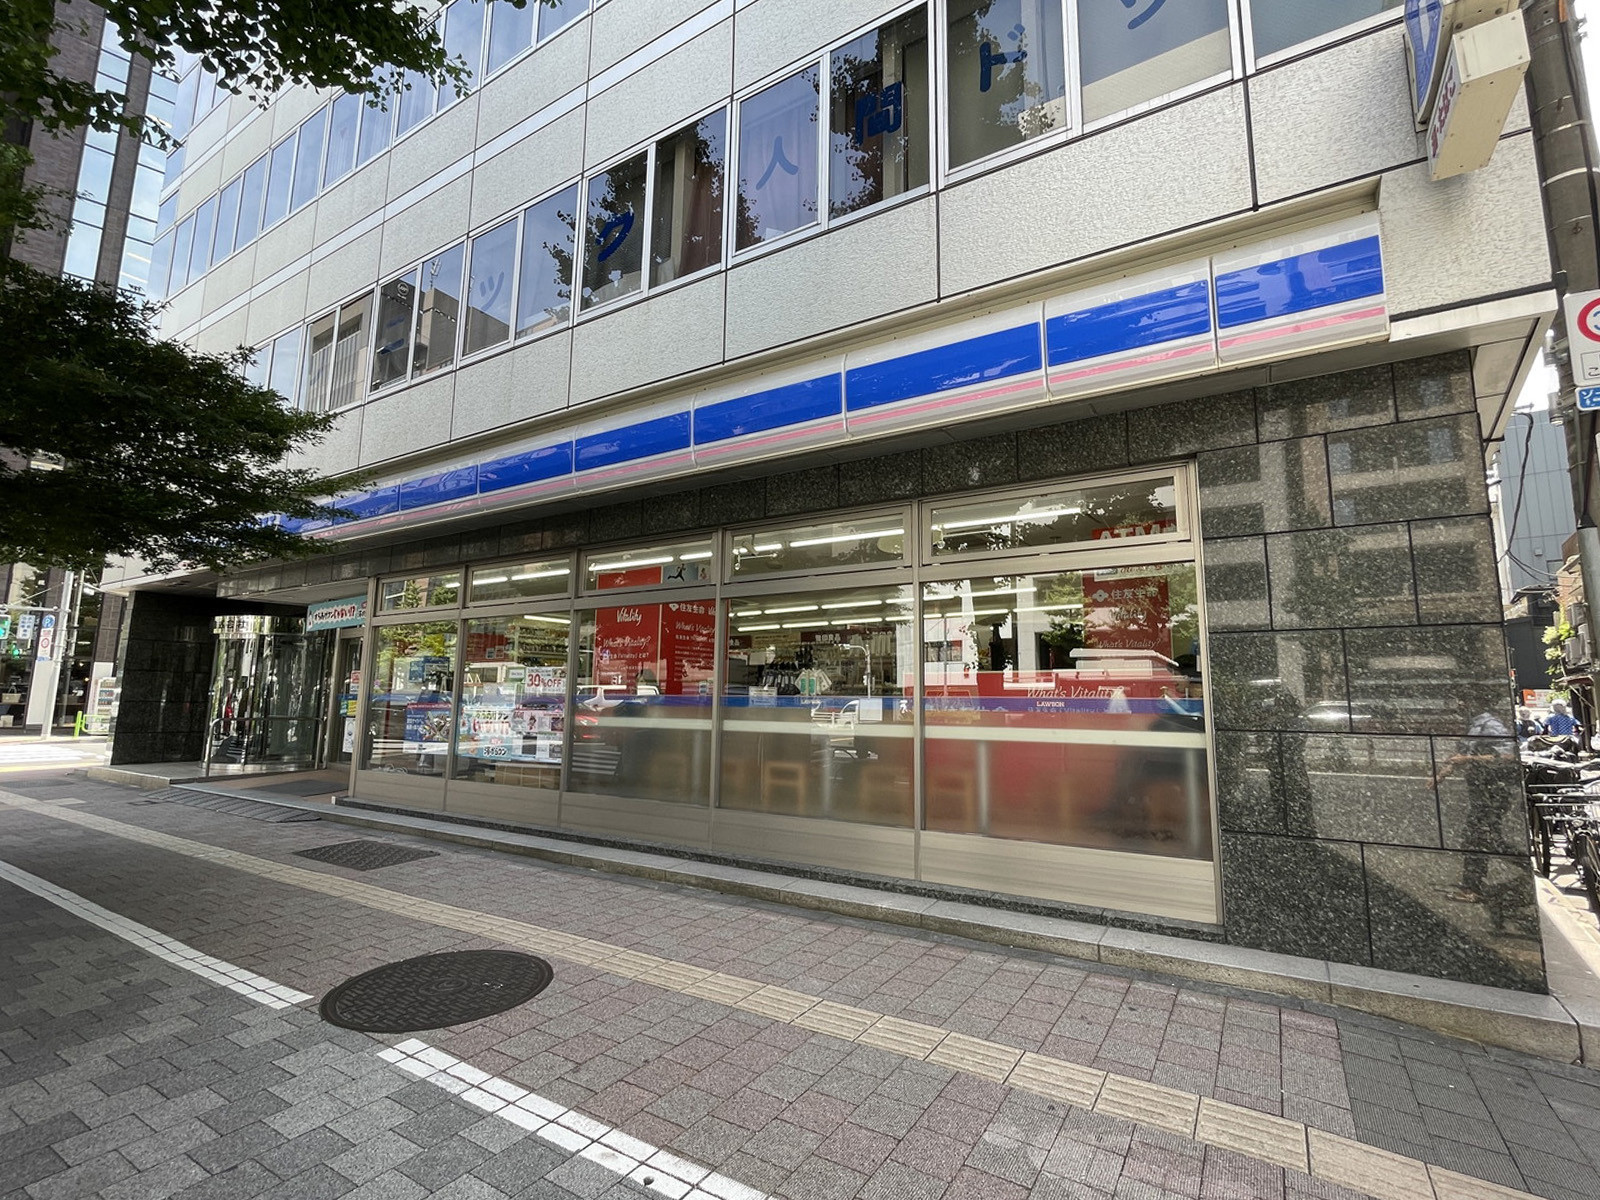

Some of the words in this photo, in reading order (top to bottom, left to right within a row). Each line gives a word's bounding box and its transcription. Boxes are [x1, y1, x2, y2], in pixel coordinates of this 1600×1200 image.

[616, 606, 642, 626] Vitality
[1125, 638, 1162, 650] Vitality?
[527, 673, 562, 688] 30%OFF
[1026, 686, 1067, 698] What's
